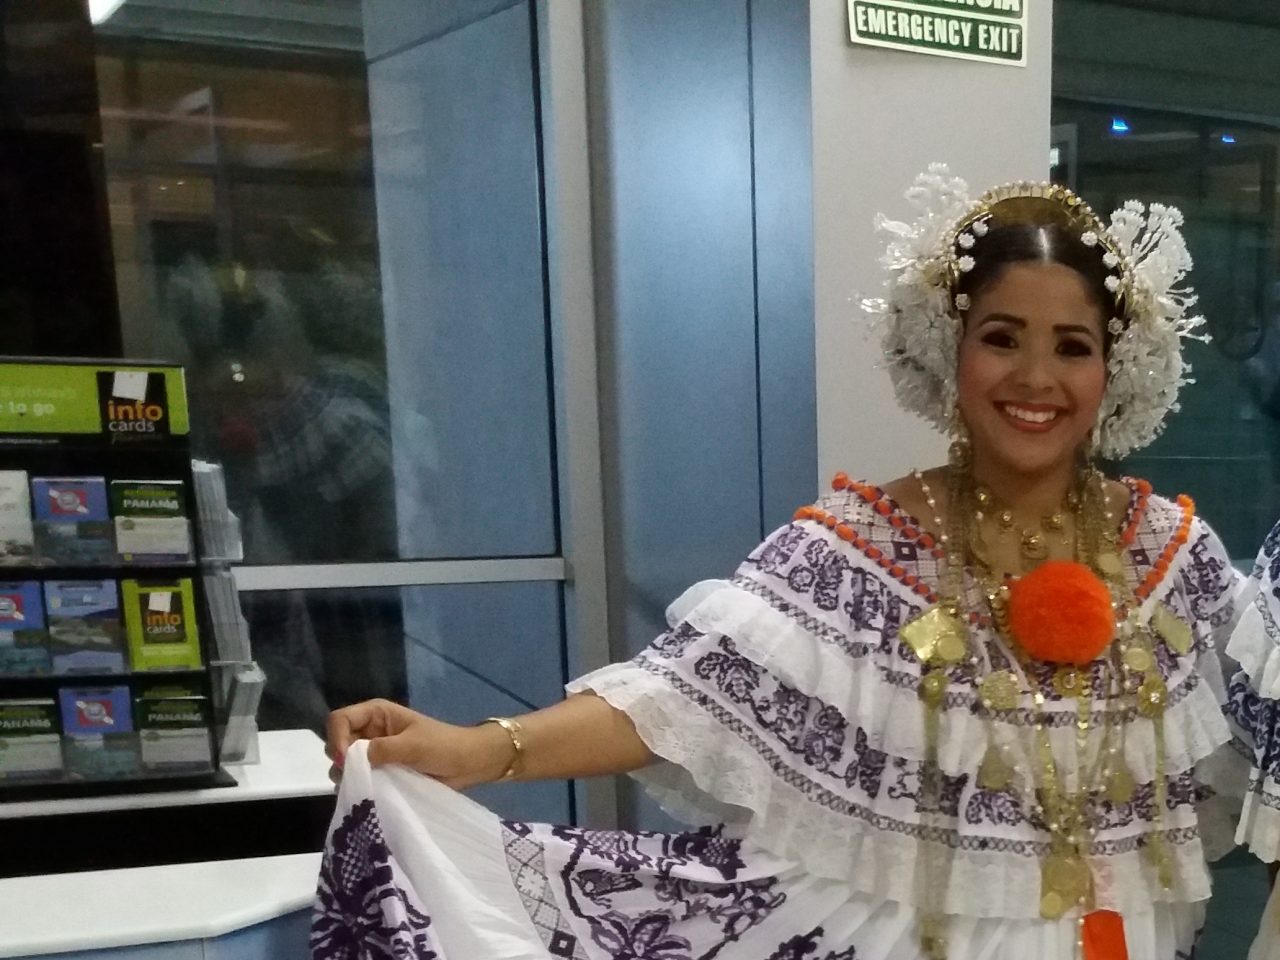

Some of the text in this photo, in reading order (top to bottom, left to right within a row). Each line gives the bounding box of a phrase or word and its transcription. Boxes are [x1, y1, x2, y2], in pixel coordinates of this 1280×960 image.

[856, 5, 1020, 54] EMERGENCY EXIT
[33, 402, 56, 416] go
[107, 400, 163, 421] info
[108, 420, 156, 432] cards
[147, 612, 182, 625] info
[147, 624, 177, 634] cards
